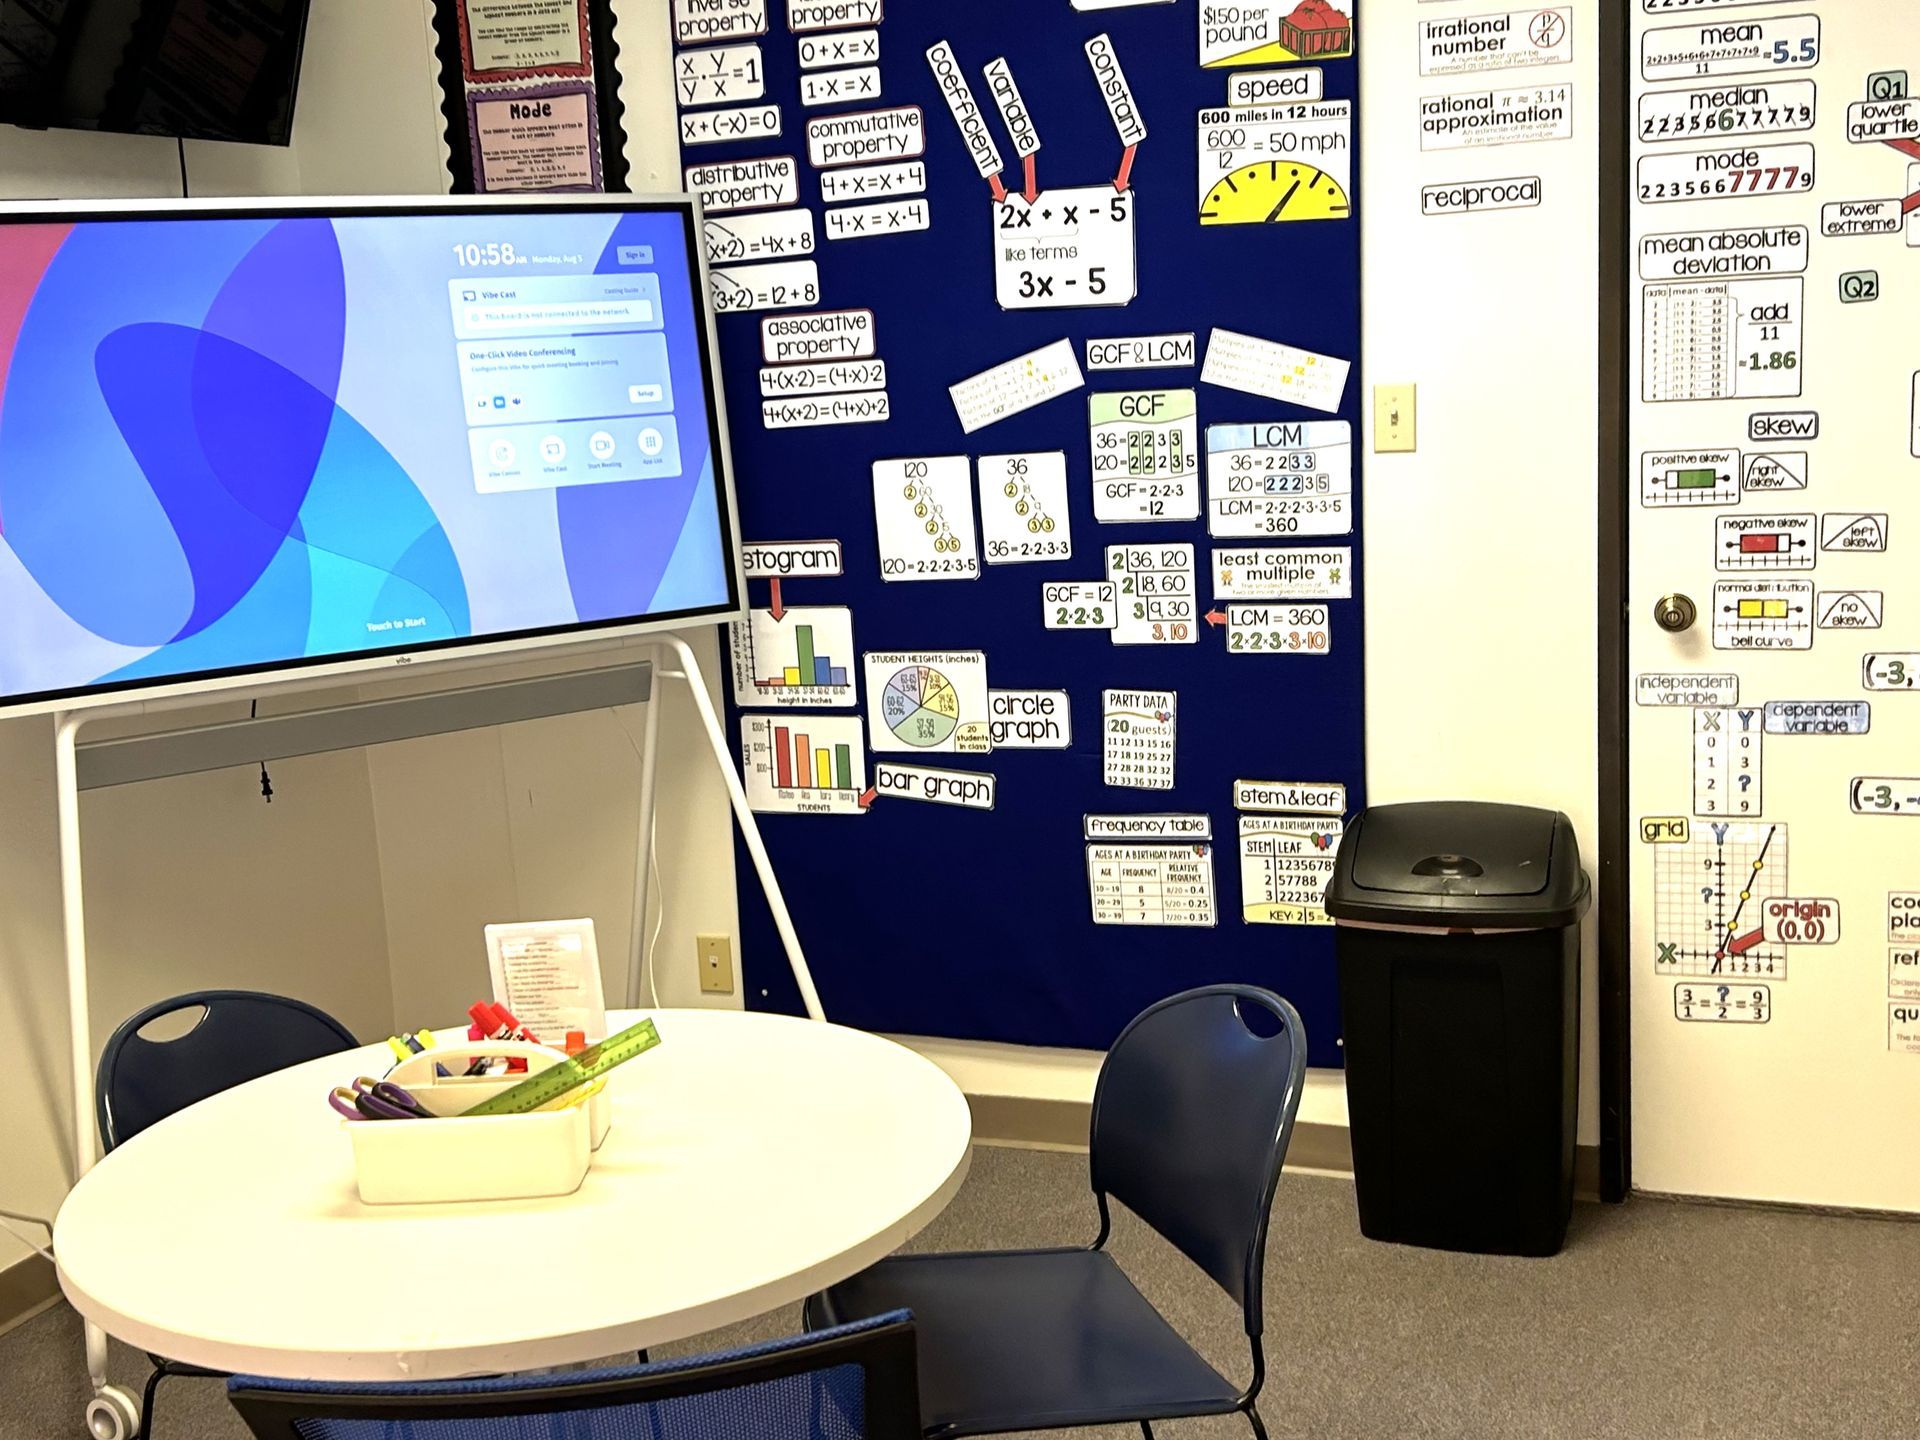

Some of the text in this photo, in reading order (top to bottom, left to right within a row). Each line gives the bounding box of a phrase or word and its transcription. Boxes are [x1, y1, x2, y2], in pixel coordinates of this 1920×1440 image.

[792, 2, 878, 25] property
[1243, 7, 1269, 23] per
[679, 12, 762, 40] property
[1206, 21, 1268, 48] pound
[1427, 15, 1510, 39] irrational
[1701, 24, 1763, 45] mean
[1432, 36, 1506, 56] number
[1773, 38, 1815, 63] 5.5
[1696, 63, 1709, 74] 11
[1089, 39, 1142, 139] constant
[1238, 73, 1309, 103] speed
[1873, 76, 1903, 100] Q1
[989, 61, 1035, 151] variable
[1423, 88, 1566, 115] rational 3.14
[1690, 87, 1768, 110] median
[510, 102, 552, 119] Mode
[930, 47, 999, 170] coefficient
[1201, 105, 1348, 124] 600 miles in 12 hours
[1861, 103, 1911, 120] lower
[810, 112, 919, 138] commutative
[1423, 106, 1563, 134] approximation
[1851, 118, 1918, 139] quartile
[823, 134, 908, 162] property
[1208, 129, 1346, 155] 600 50 mph
[1219, 151, 1233, 169] 12
[1696, 150, 1759, 171] mode
[692, 161, 789, 186] distributive
[702, 184, 783, 208] property
[1424, 180, 1538, 211] reciprocal
[1000, 197, 1126, 229] 2x x 5
[1840, 203, 1884, 216] lower
[1827, 218, 1896, 233] extreme
[1645, 228, 1801, 254] mean absolute
[453, 243, 515, 266] 10:58
[532, 255, 563, 265] Monday,
[564, 255, 577, 265] Aug
[1005, 245, 1078, 262] like terms
[1673, 254, 1771, 275] deviation
[1018, 267, 1106, 298] 3x 5
[1844, 276, 1875, 298] Q2
[482, 291, 516, 299] Vibe Cast
[1750, 304, 1788, 321] add
[768, 314, 867, 336] associative
[1760, 326, 1780, 340] 11
[470, 348, 576, 360] One-Click Video Conferencing
[777, 336, 860, 359] property
[1749, 352, 1796, 370] 1.86
[638, 390, 654, 398] Setup
[1120, 395, 1165, 417] GCF
[1753, 417, 1814, 435] skew
[1096, 433, 1117, 448] 36
[1254, 425, 1302, 447] LCM
[1007, 459, 1028, 475] 36
[1095, 455, 1118, 470] 120
[1231, 454, 1251, 471] 36
[1652, 454, 1730, 466] positive skew
[904, 462, 928, 478] 120
[1752, 465, 1779, 477] right
[1106, 483, 1137, 498] GCF
[1229, 475, 1253, 492] 120
[1750, 477, 1784, 487] skew
[1219, 501, 1253, 515] LCM
[1266, 517, 1297, 532] 360
[1724, 519, 1808, 530] negative skew
[1851, 526, 1875, 538] left
[1842, 537, 1878, 548] skew
[1220, 552, 1342, 567] least common
[1246, 566, 1315, 581] multiple
[1046, 586, 1112, 602] GCF 12
[1718, 583, 1809, 593] normal distribution
[1841, 602, 1858, 613] no
[366, 617, 426, 632] Touch to Start
[1231, 609, 1325, 626] LCM 360
[1832, 614, 1867, 626] skew
[1731, 635, 1793, 647] bell curve
[396, 656, 412, 664] vibe
[871, 654, 979, 664] STUDENT HEIGHTS (inches)
[1640, 675, 1735, 690] independent
[778, 697, 803, 705] height
[993, 695, 1054, 715] circle
[1110, 694, 1168, 708] PARTY DATA
[1657, 692, 1718, 704] variable
[1773, 703, 1861, 718] dependent
[1703, 711, 1754, 731] X Y
[1786, 719, 1849, 732] variable
[990, 718, 1060, 743] graph
[880, 767, 990, 802] bar graph
[797, 804, 831, 812] STUDENTS
[1091, 819, 1204, 834] frequency table
[1243, 821, 1338, 830] AGES BIRTHDAY PARTY
[1644, 822, 1684, 841] grid
[1095, 850, 1191, 860] AGES BIRTHDAY PARTY
[1247, 841, 1302, 854] STEM LEAF
[1101, 868, 1157, 878] AGE FREQUENCY
[1168, 864, 1198, 872] RELATIVE
[1167, 874, 1201, 882] FREQUENCY
[1279, 875, 1317, 886] 57788
[1769, 902, 1831, 922] origin
[1894, 1008, 1919, 1022] qu
